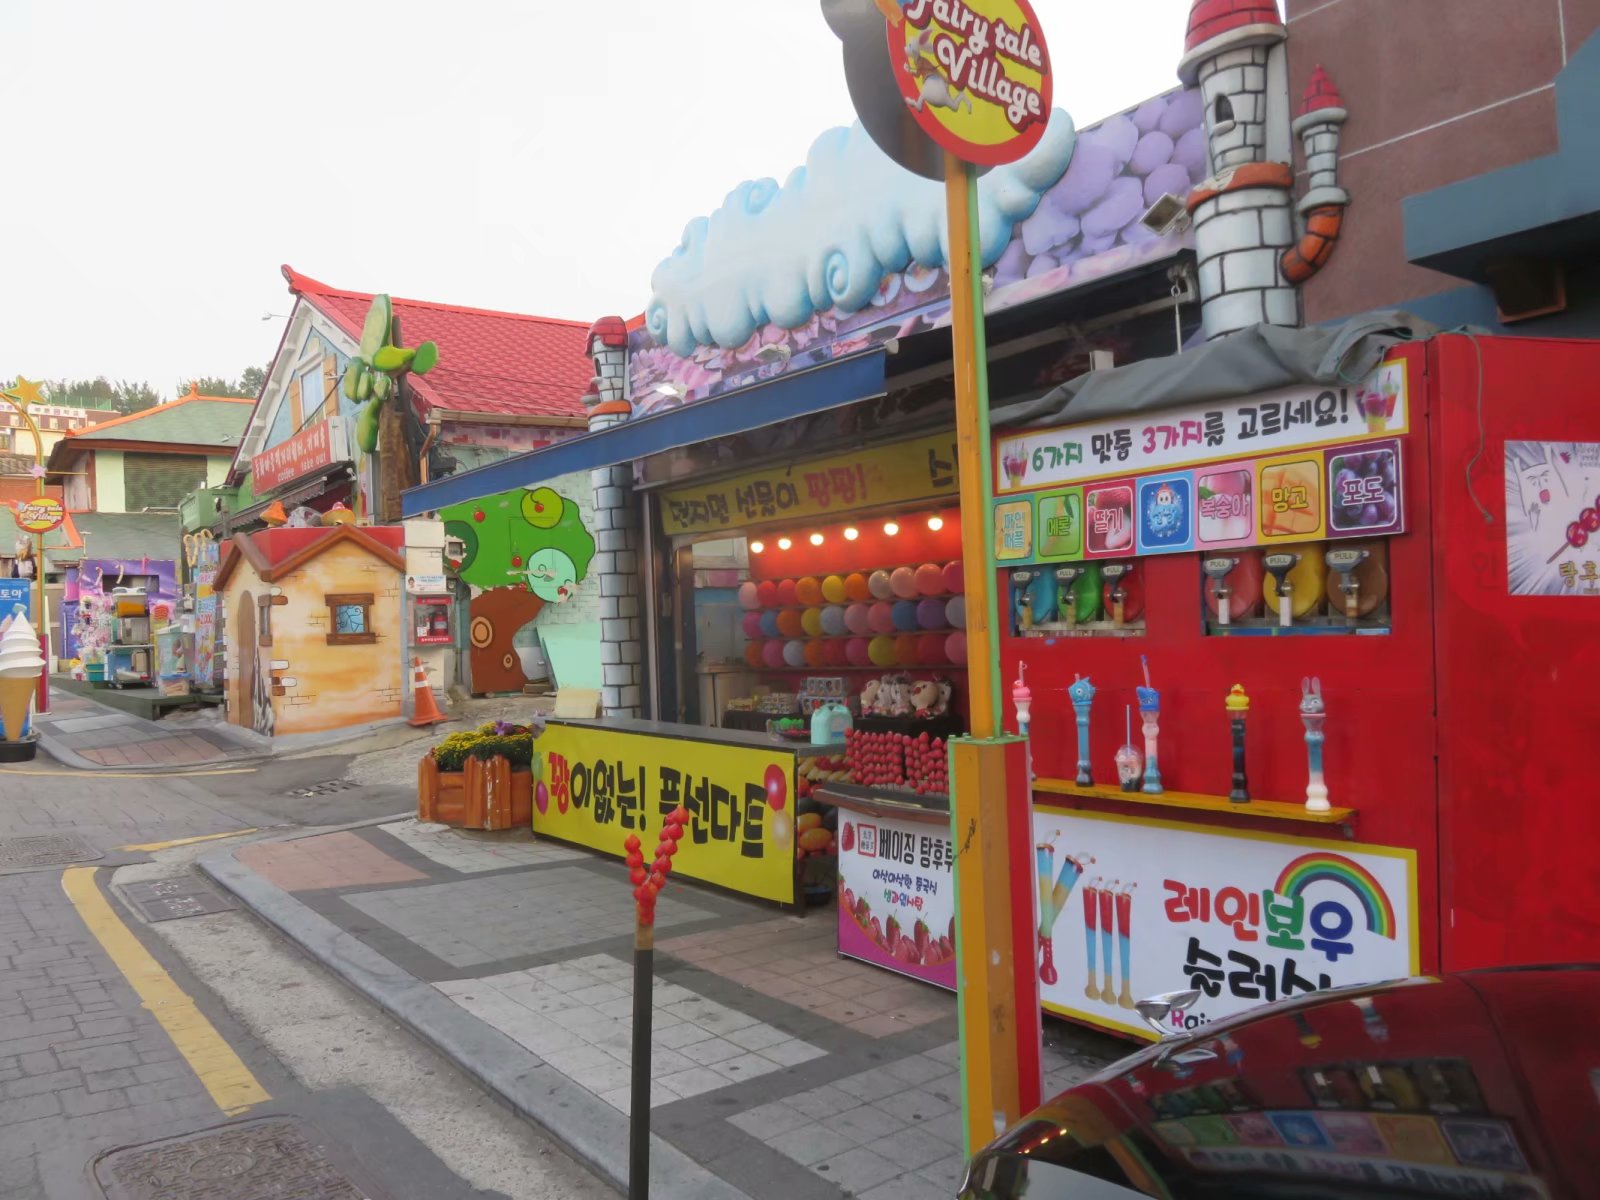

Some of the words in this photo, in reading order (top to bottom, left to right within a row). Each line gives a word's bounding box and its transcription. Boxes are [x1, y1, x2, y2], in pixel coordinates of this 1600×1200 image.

[994, 24, 1042, 67] tale
[936, 38, 1042, 125] Village
[1032, 441, 1083, 472] 6가지
[1142, 410, 1225, 454] 3가지를
[1236, 388, 1349, 441] 고르세요!
[735, 479, 799, 517] 선물이
[1271, 485, 1309, 513] 망고
[1340, 475, 1385, 506] 포도
[1094, 506, 1124, 534] 딸기
[1200, 495, 1248, 520] 복숭아
[1334, 552, 1354, 560] PULL
[1559, 560, 1600, 588] 탕후
[548, 751, 646, 832] 꽝이없는!
[879, 828, 915, 865] 베이징
[883, 888, 924, 911] 생과일사탕
[915, 876, 938, 896] 중국식
[1163, 879, 1354, 962] 레인보우
